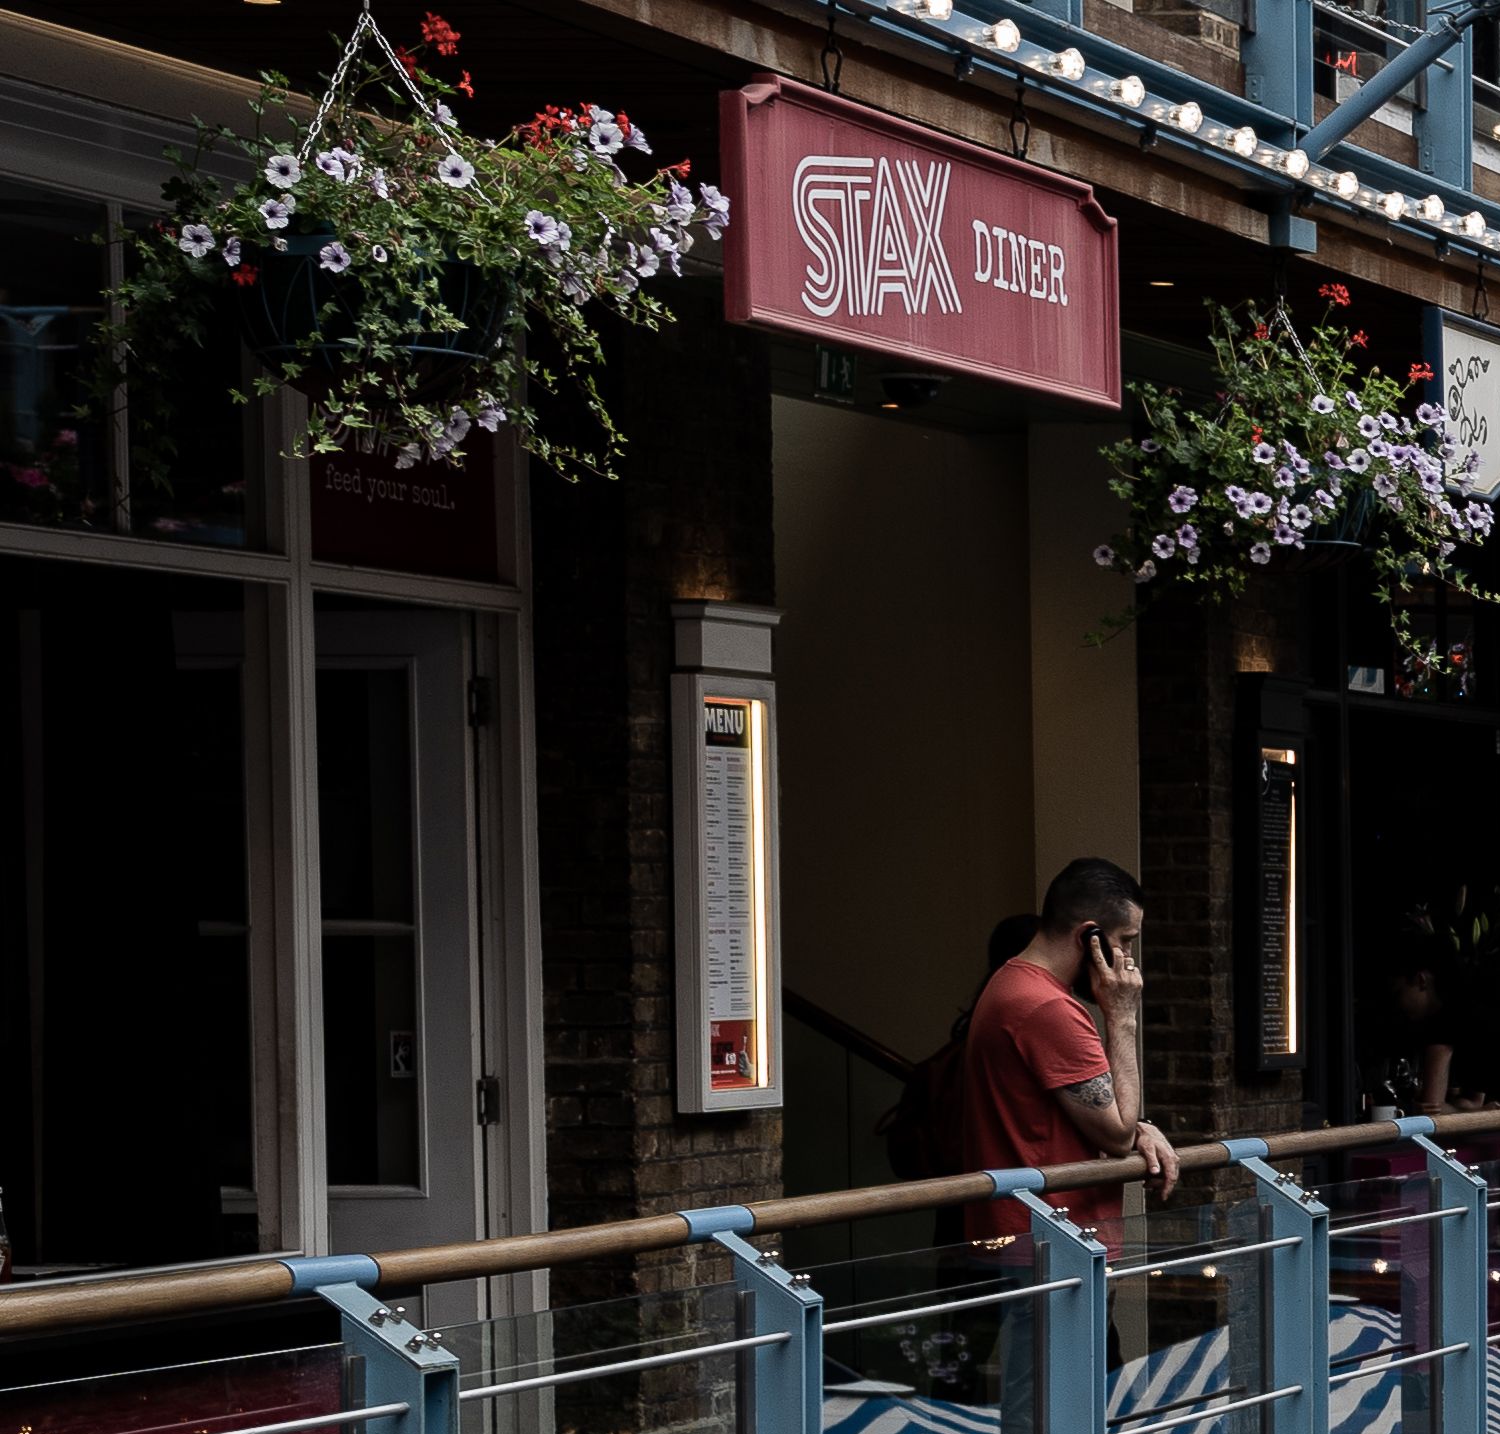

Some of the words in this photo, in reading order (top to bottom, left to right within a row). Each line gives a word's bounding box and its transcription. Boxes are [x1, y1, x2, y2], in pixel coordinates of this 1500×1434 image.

[792, 156, 963, 317] STAX
[972, 219, 1069, 308] DINER
[325, 462, 362, 494] feed
[366, 475, 408, 504] your
[411, 483, 456, 511] soul.
[704, 707, 744, 735] MENU
